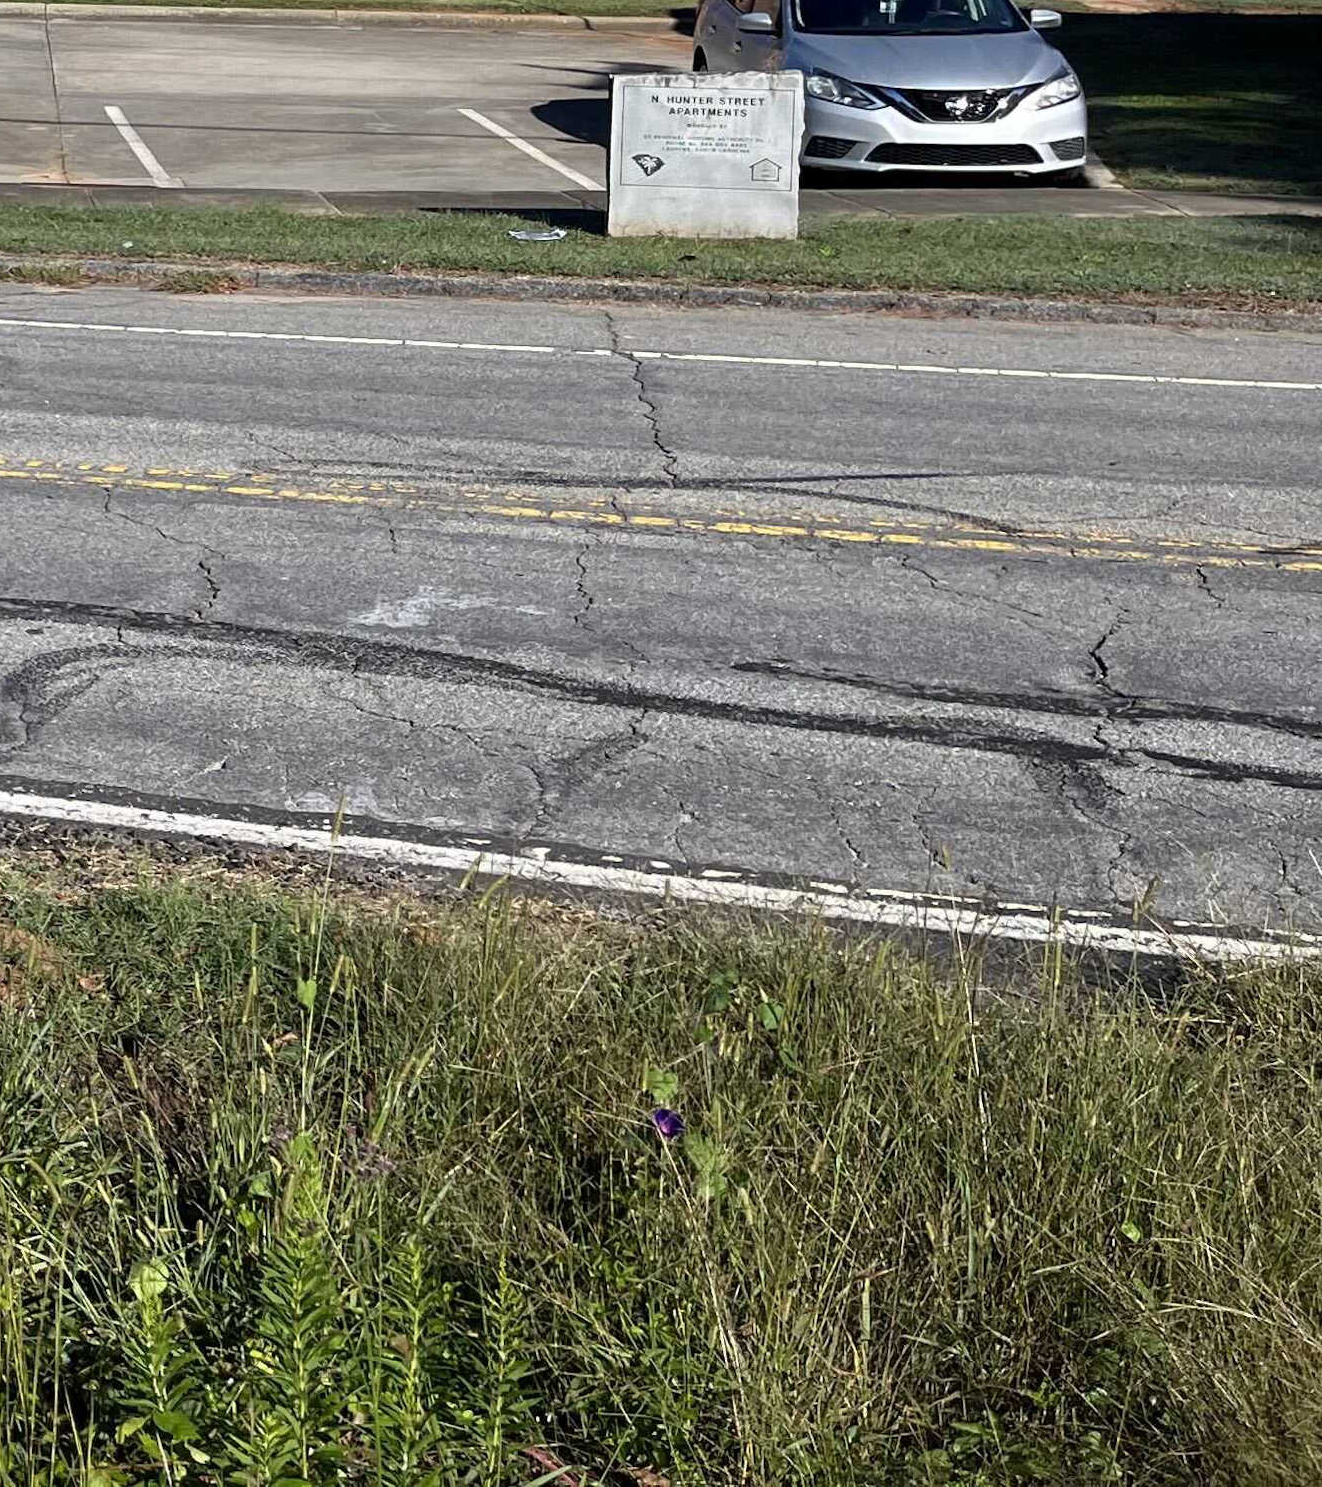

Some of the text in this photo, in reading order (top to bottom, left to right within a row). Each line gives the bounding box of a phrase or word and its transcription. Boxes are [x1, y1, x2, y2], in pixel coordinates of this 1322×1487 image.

[667, 96, 713, 105] HUNTER
[719, 97, 765, 106] STREET
[669, 108, 748, 117] APARTMENTS
